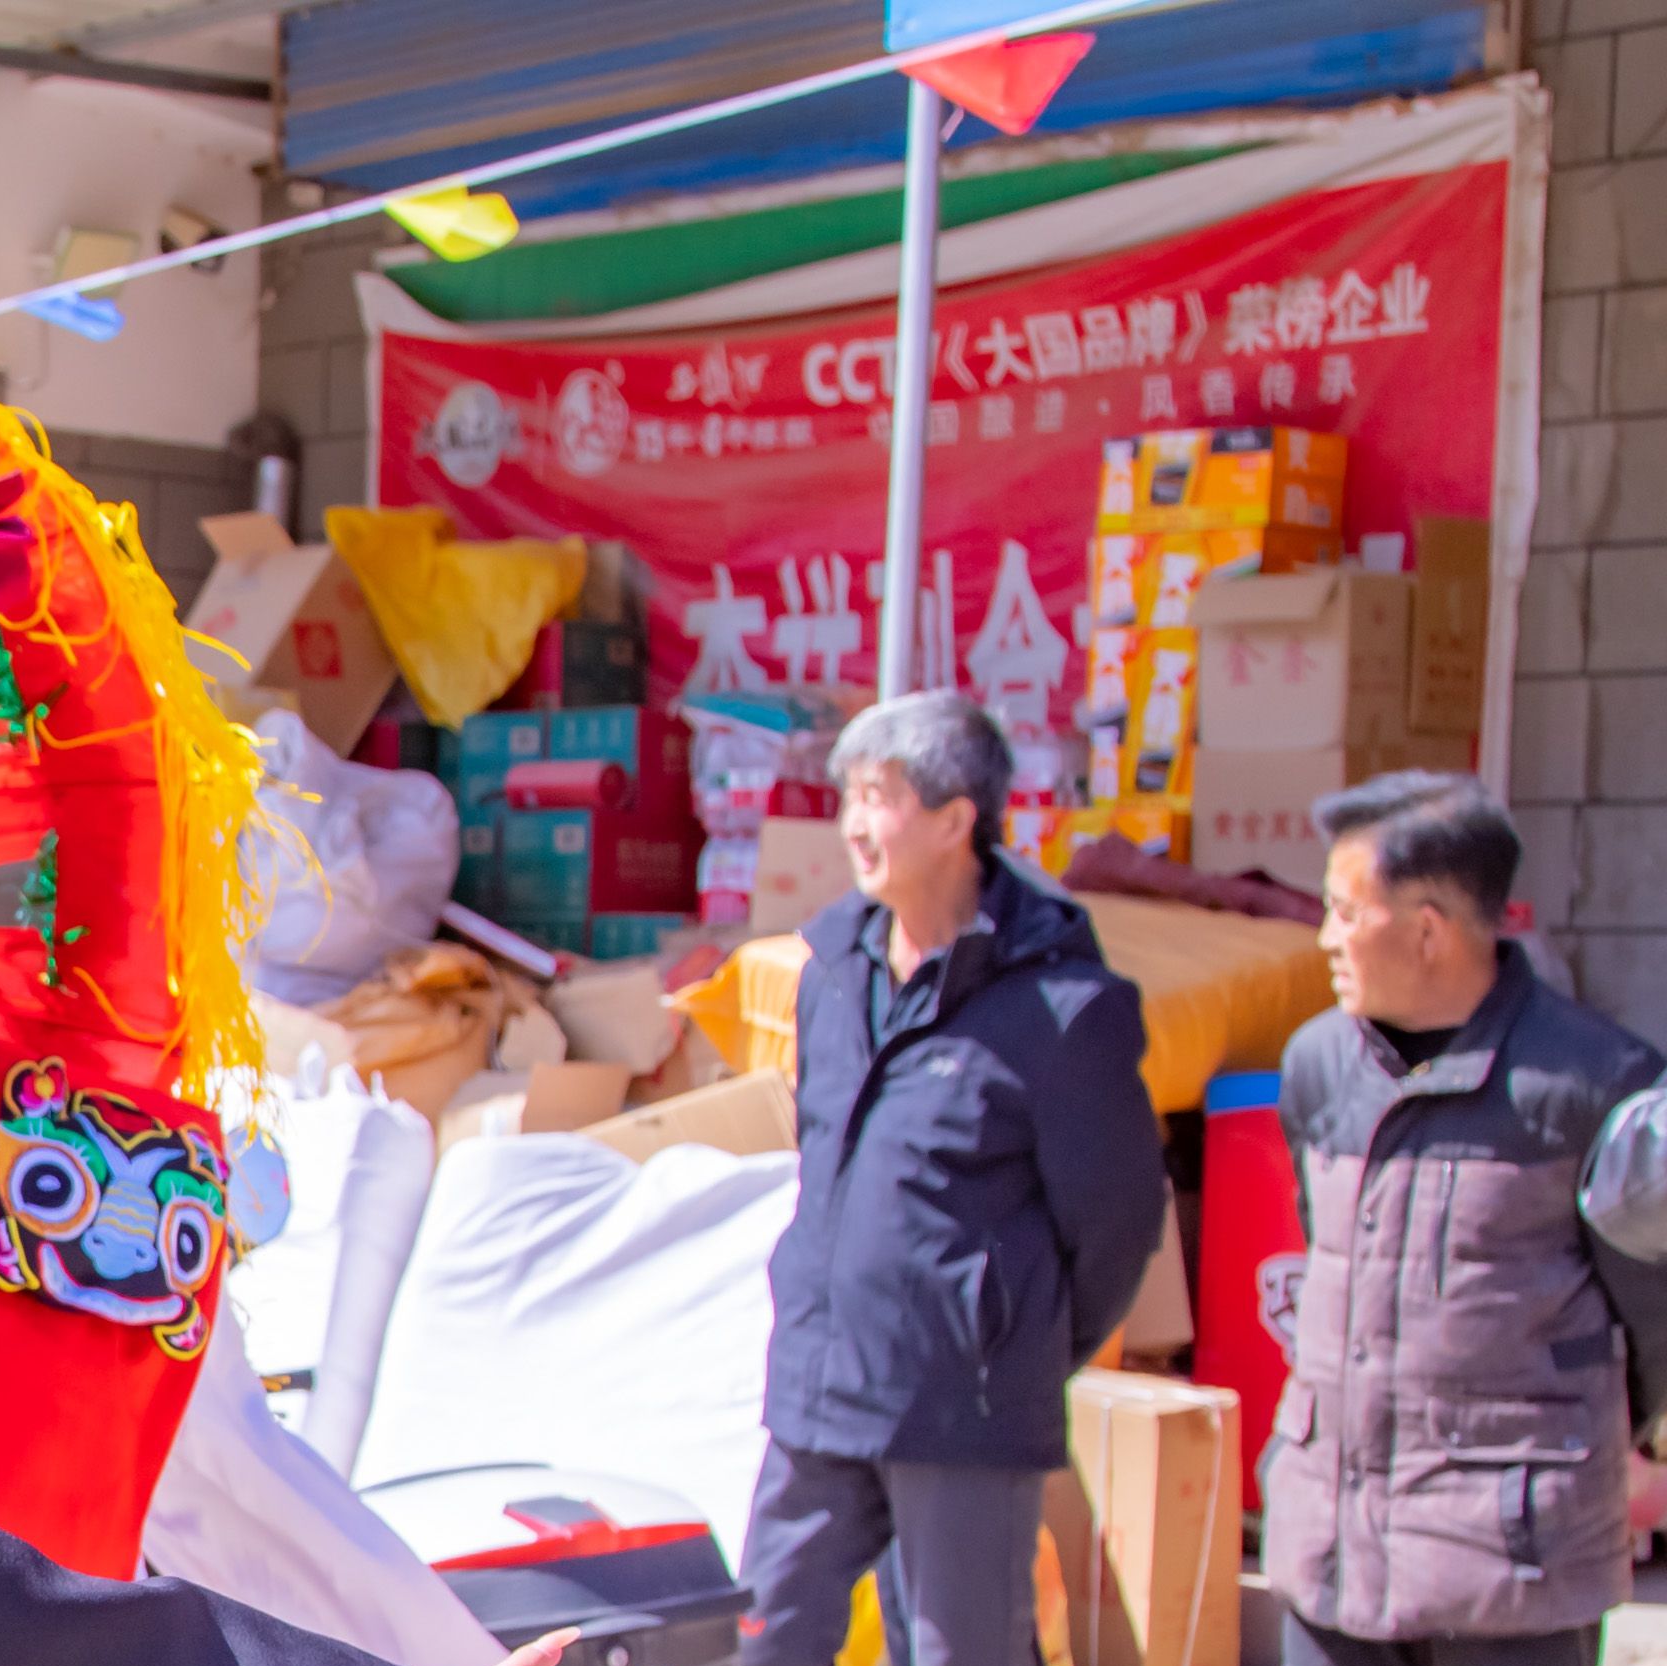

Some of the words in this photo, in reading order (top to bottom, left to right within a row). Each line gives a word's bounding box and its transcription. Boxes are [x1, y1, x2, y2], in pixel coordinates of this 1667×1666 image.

[802, 262, 1431, 406] CCT《大国品牌》荣榜企业
